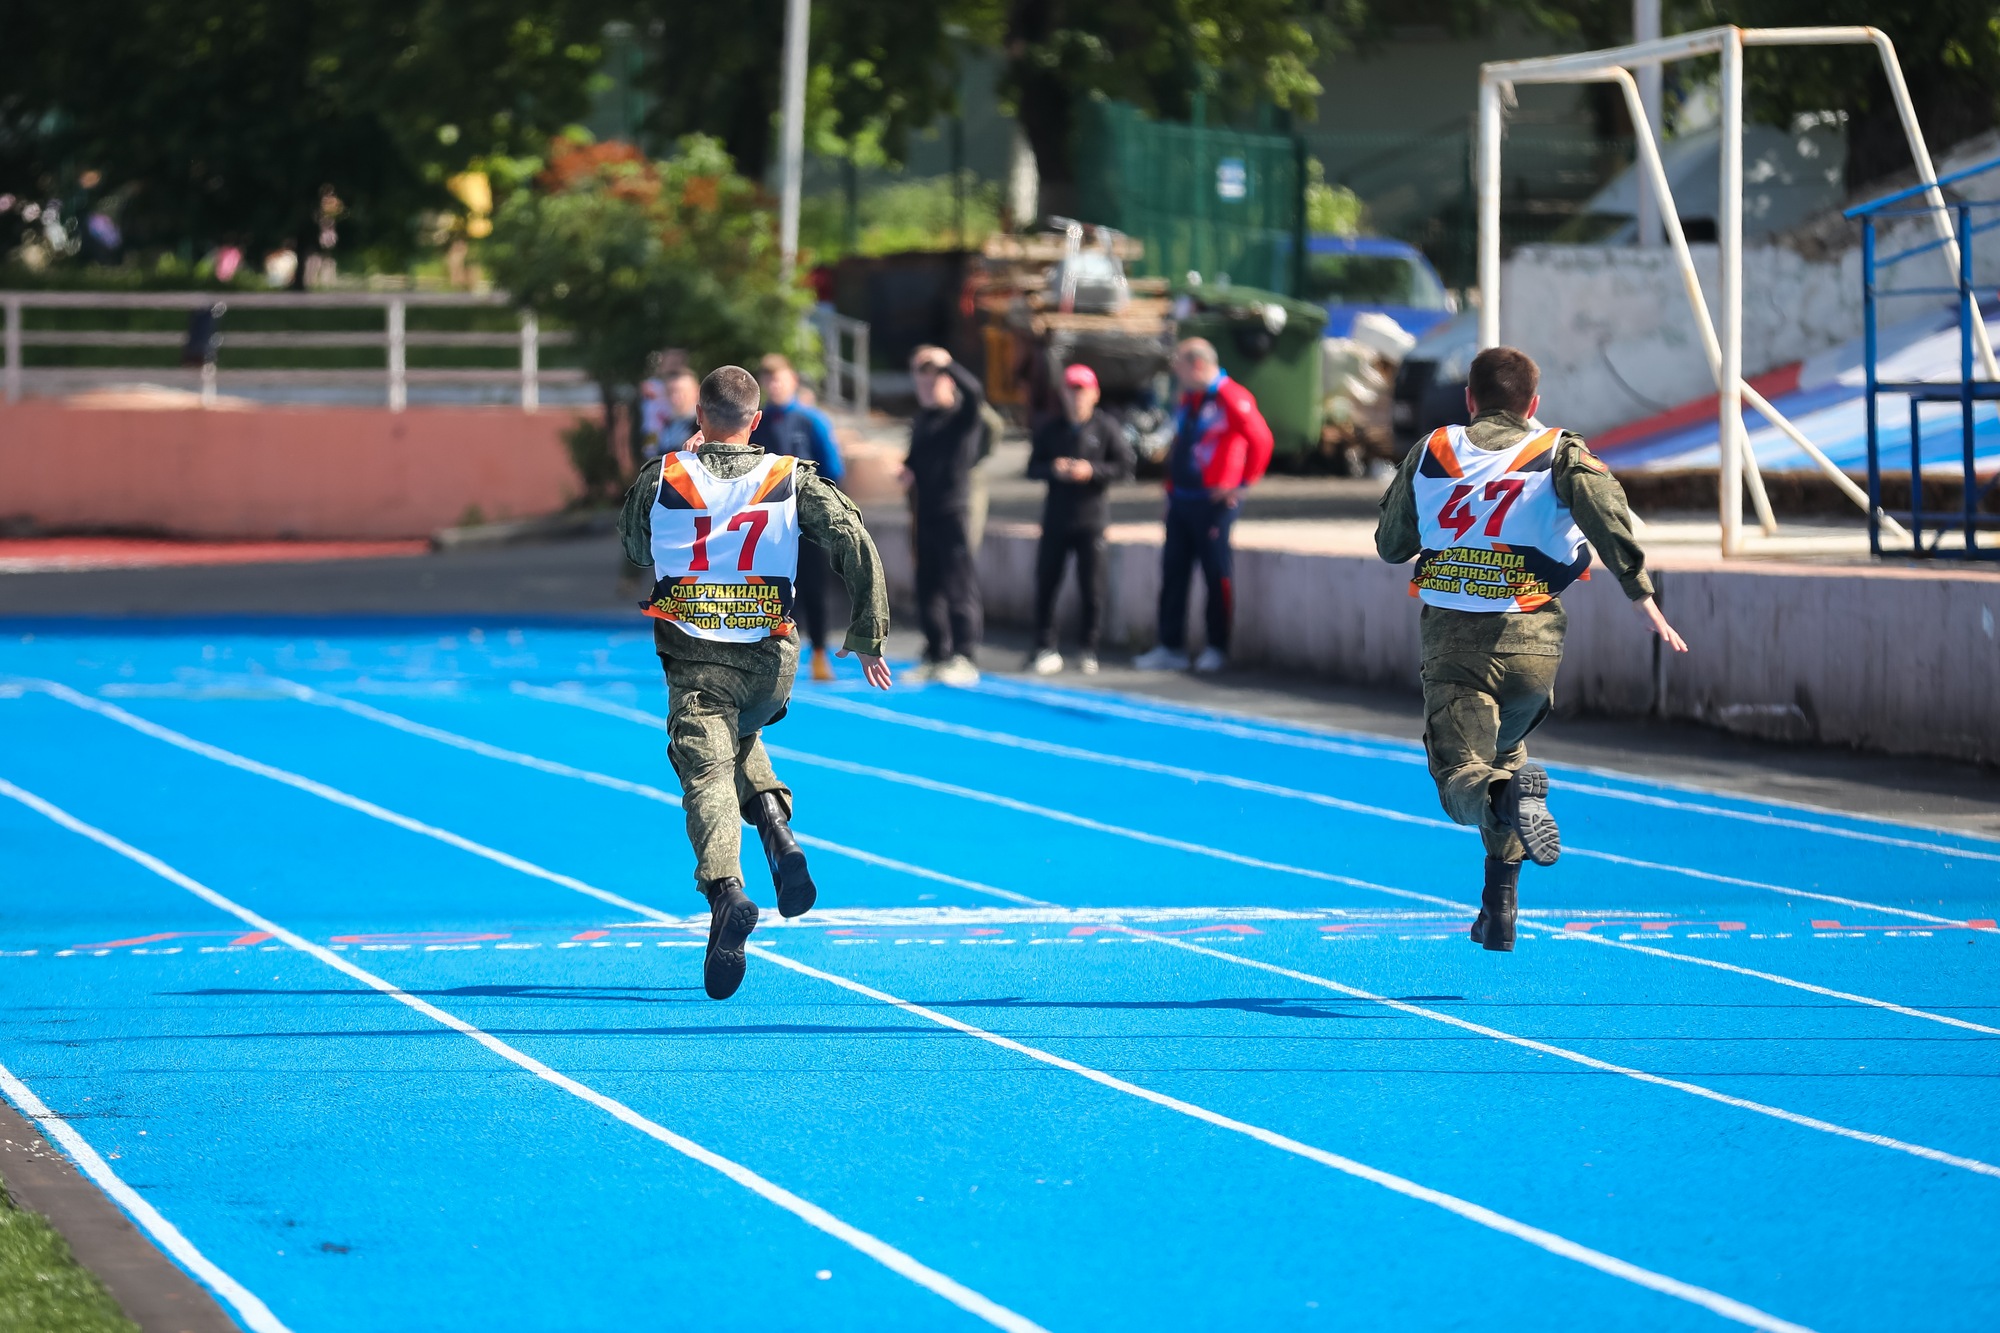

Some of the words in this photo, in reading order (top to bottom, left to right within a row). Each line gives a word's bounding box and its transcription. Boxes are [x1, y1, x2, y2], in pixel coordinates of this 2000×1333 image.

[1438, 479, 1526, 542] 47
[688, 510, 769, 571] 17
[1506, 569, 1535, 584] Сил
[763, 601, 783, 615] Си
